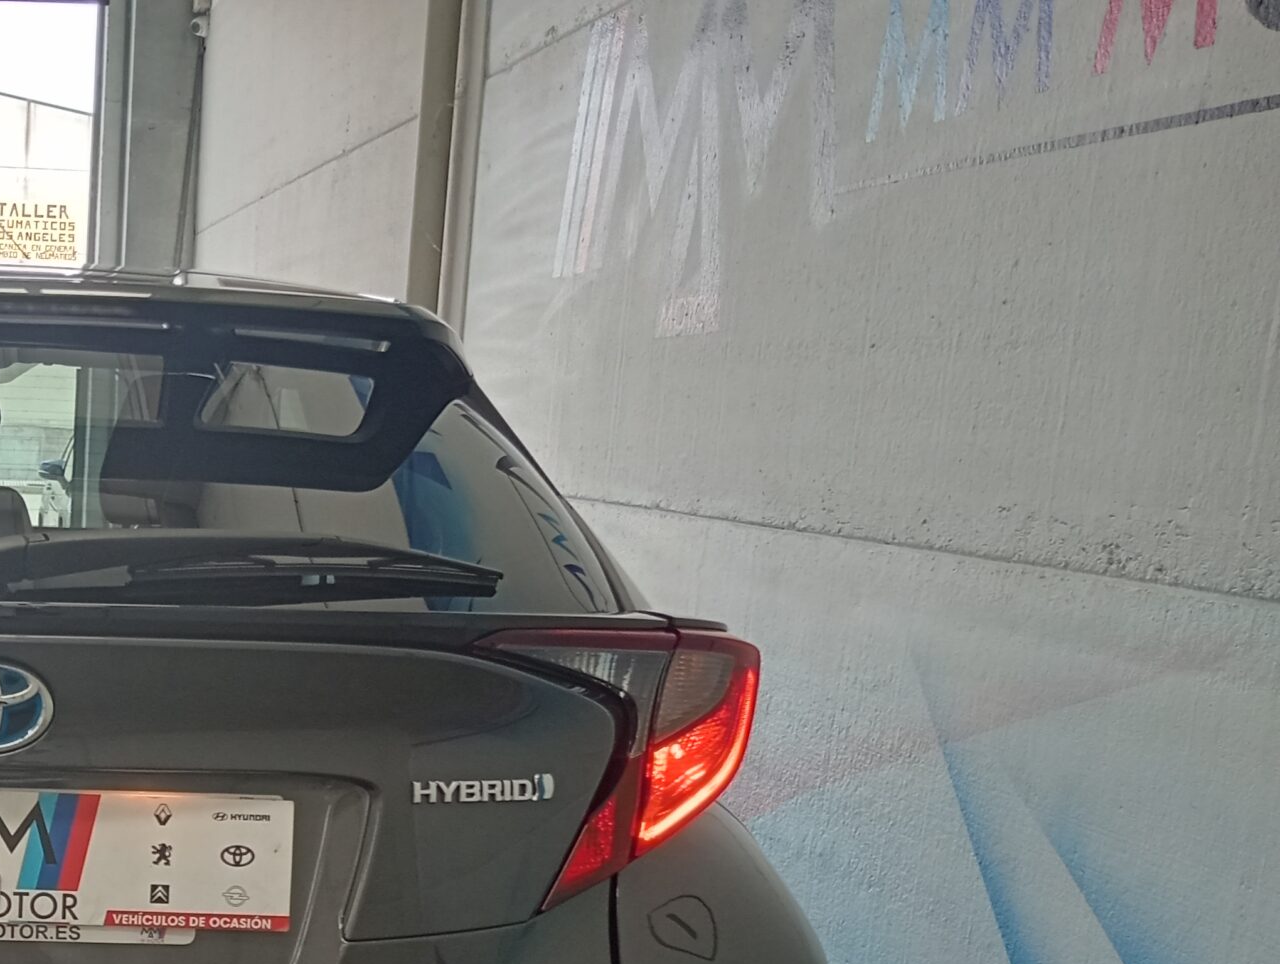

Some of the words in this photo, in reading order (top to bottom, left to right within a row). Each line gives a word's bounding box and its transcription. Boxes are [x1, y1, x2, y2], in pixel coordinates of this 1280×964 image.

[17, 232, 75, 242] ANGELES
[412, 779, 533, 803] HYBRID
[230, 813, 271, 821] HYUNDAI
[112, 911, 186, 926] VEHÍCULOS
[189, 917, 207, 927] DE
[209, 916, 272, 929] OCASIÓN
